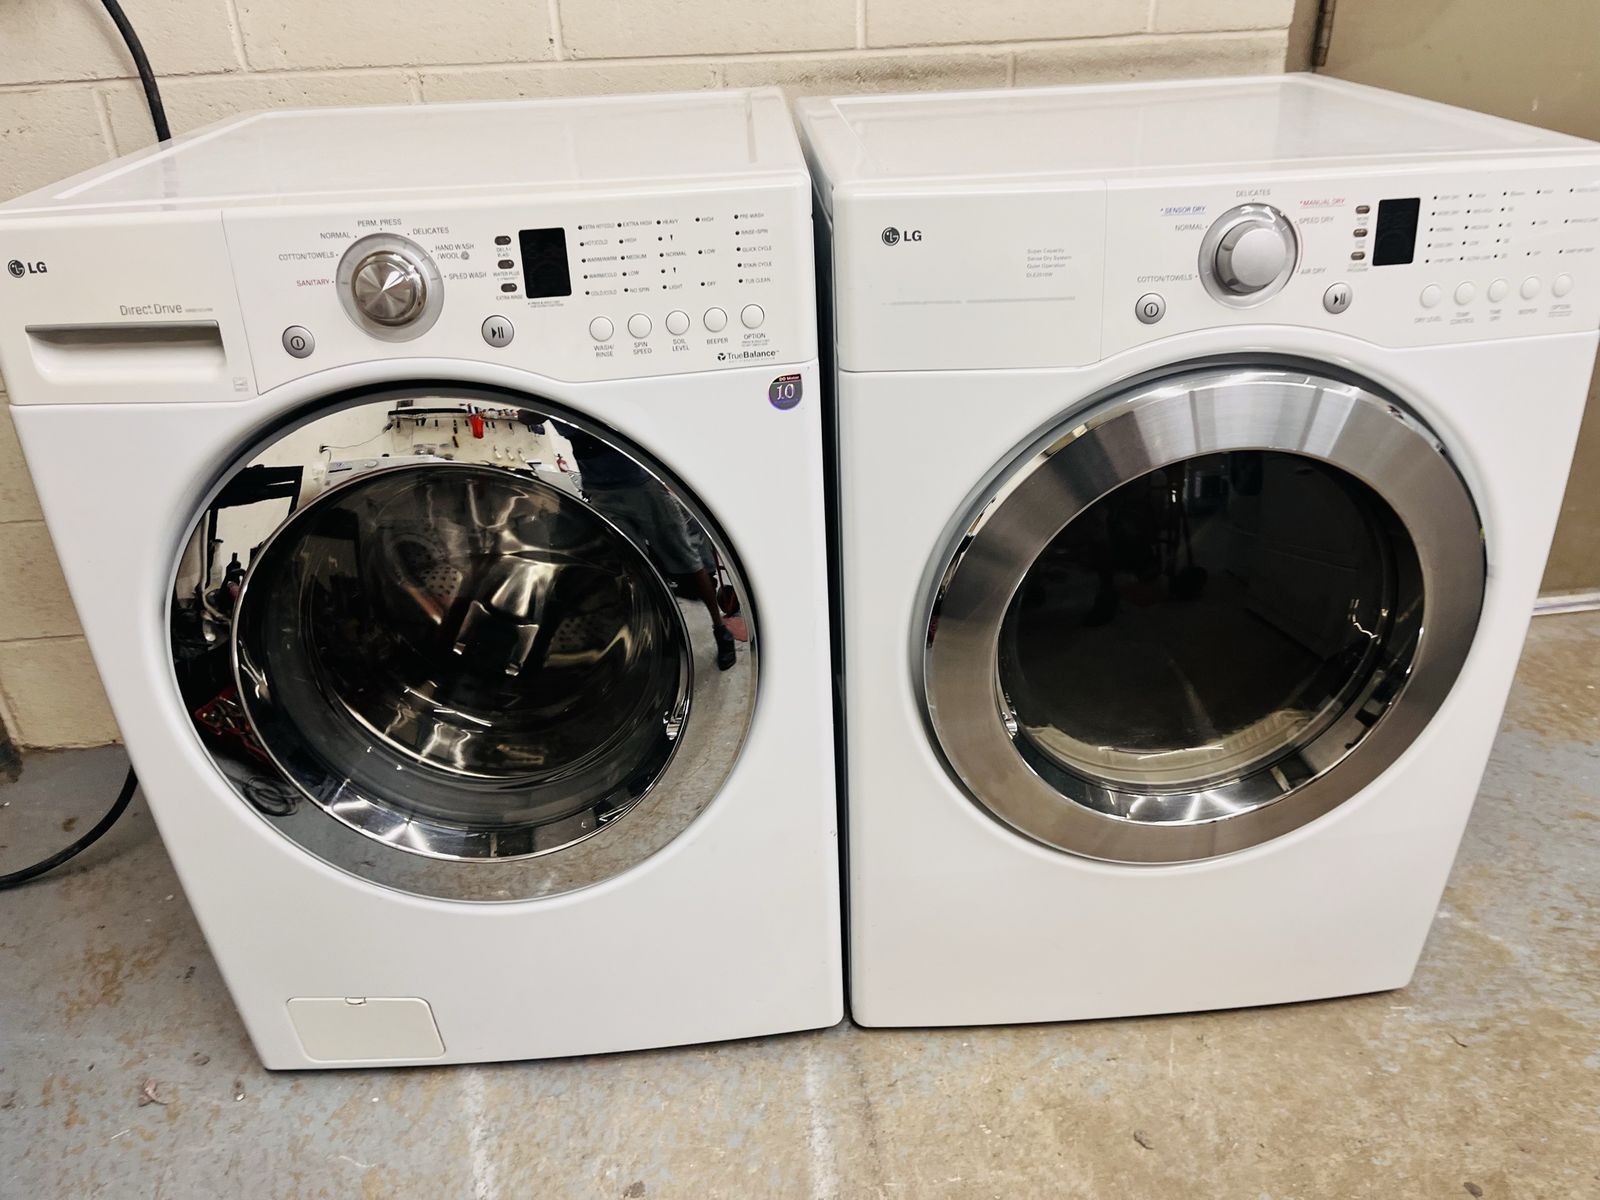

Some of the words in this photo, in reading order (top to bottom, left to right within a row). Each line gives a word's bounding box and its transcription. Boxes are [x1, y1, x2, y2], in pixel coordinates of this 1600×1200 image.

[379, 218, 402, 226] PRESS
[412, 226, 449, 236] DELICATES
[1174, 223, 1204, 232] NORMAL
[320, 231, 351, 240] NORMAL
[903, 230, 922, 242] LG
[278, 251, 335, 261] COTTON/TOWELS
[28, 261, 48, 274] LG
[448, 272, 466, 280] SPEED
[466, 271, 487, 279] WASH
[1137, 273, 1193, 283] COTTON/TOWELS
[296, 278, 330, 287] SANITARY
[119, 304, 153, 317] Direct
[153, 303, 183, 316] Drive
[706, 336, 729, 345] BEEPER
[743, 332, 766, 340] OPTION
[632, 347, 653, 355] SPEED
[672, 344, 690, 352] LEVEL
